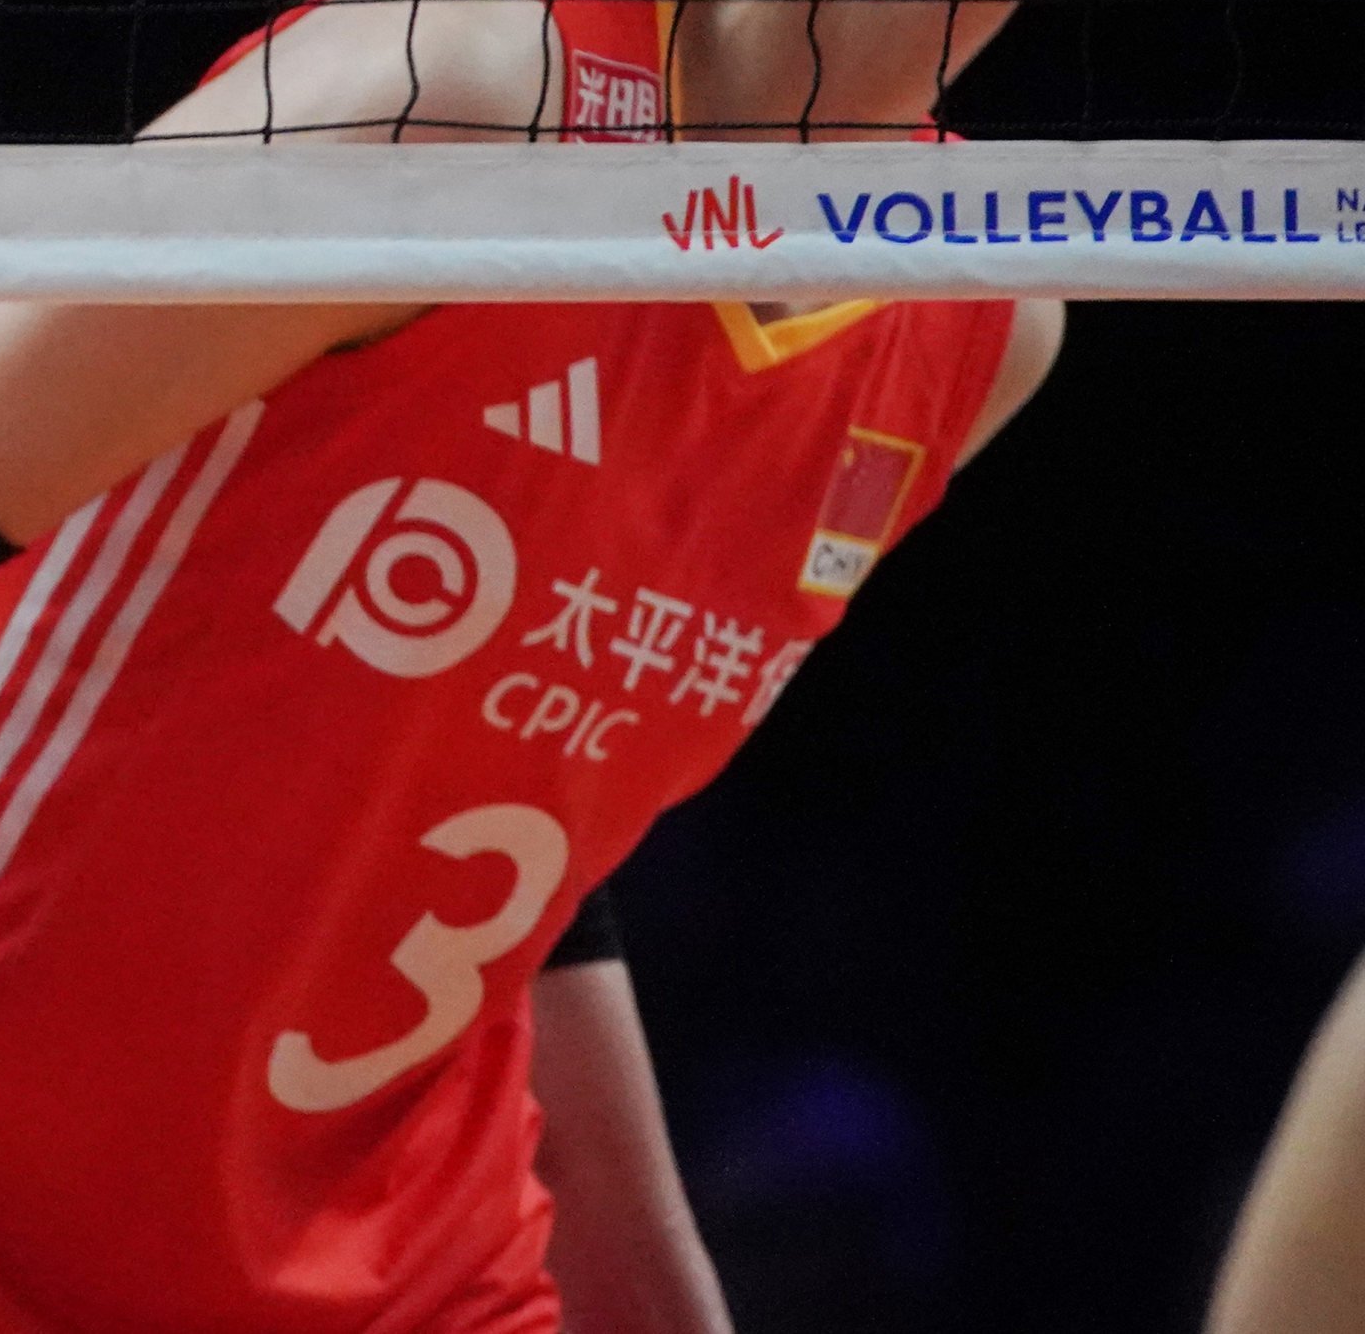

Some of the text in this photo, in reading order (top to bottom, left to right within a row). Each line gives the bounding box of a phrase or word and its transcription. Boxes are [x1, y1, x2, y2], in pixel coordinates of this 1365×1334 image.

[662, 174, 1321, 252] VNL VOLLEYBALL
[480, 672, 641, 762] CPIC
[267, 802, 570, 1114] 3
